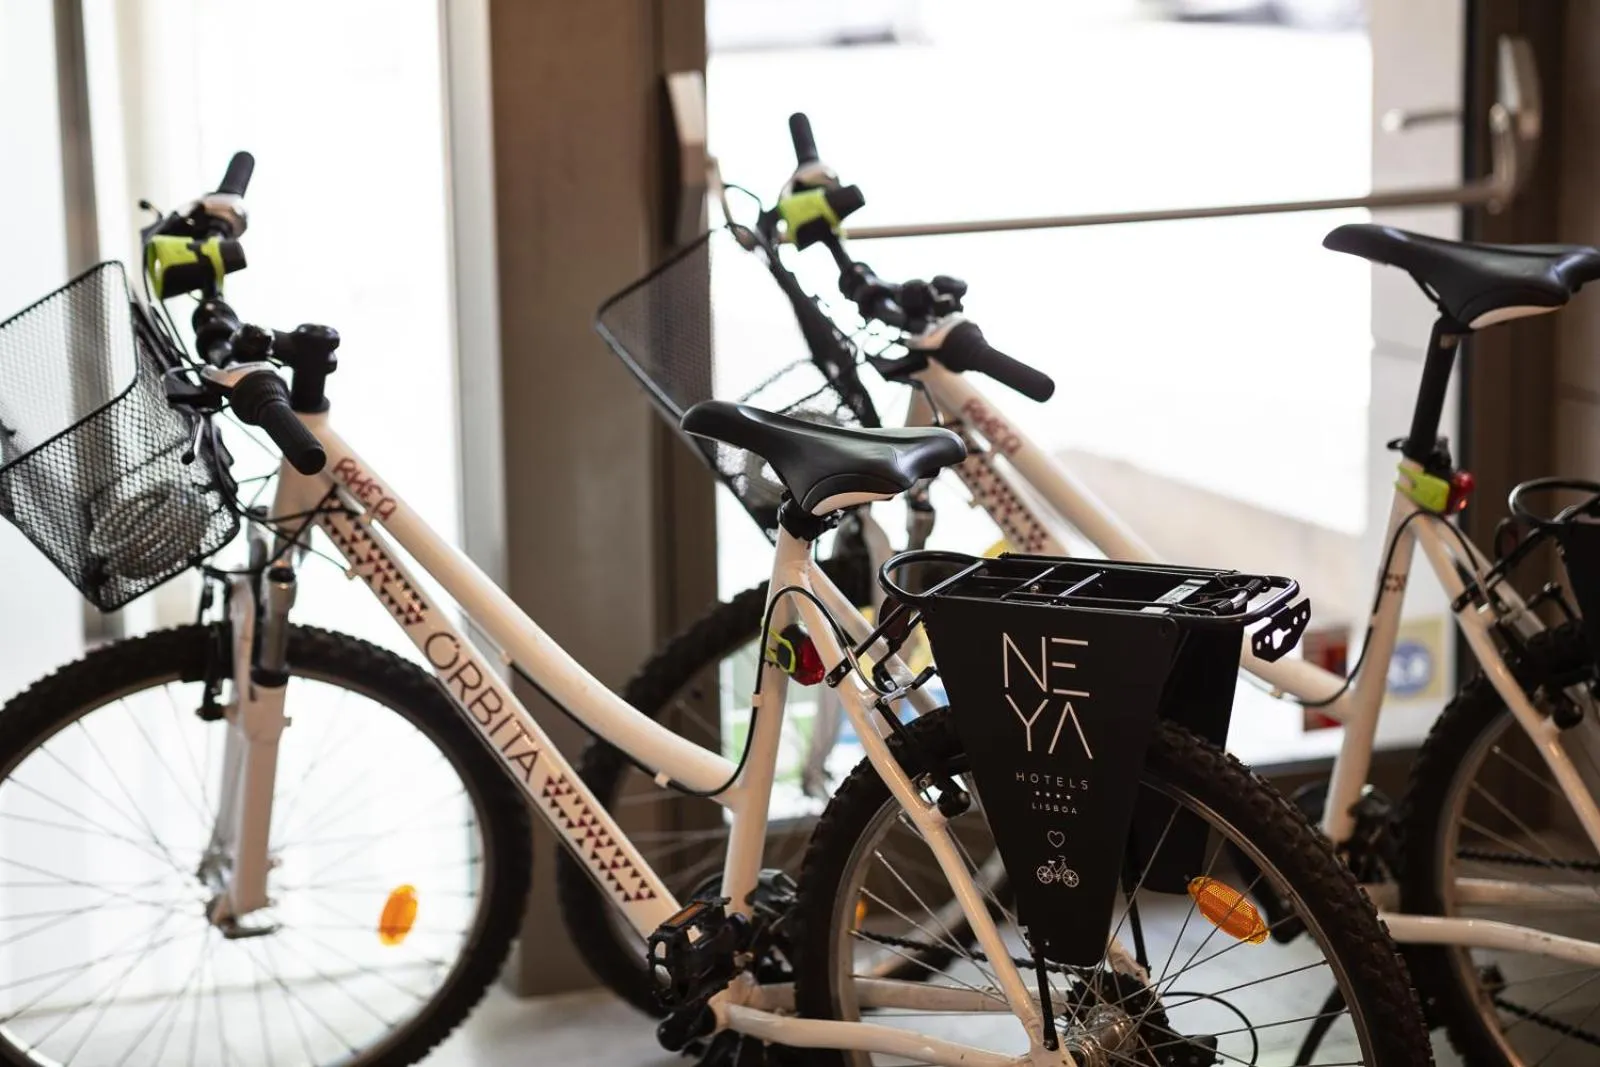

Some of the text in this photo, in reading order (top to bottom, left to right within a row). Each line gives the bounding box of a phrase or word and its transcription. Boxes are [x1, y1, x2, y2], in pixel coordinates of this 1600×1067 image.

[1003, 632, 1090, 698] NE
[424, 631, 540, 783] ORBITA
[1005, 693, 1093, 760] YA
[1016, 772, 1089, 790] HOTELS
[1031, 802, 1077, 815] LISBOA
